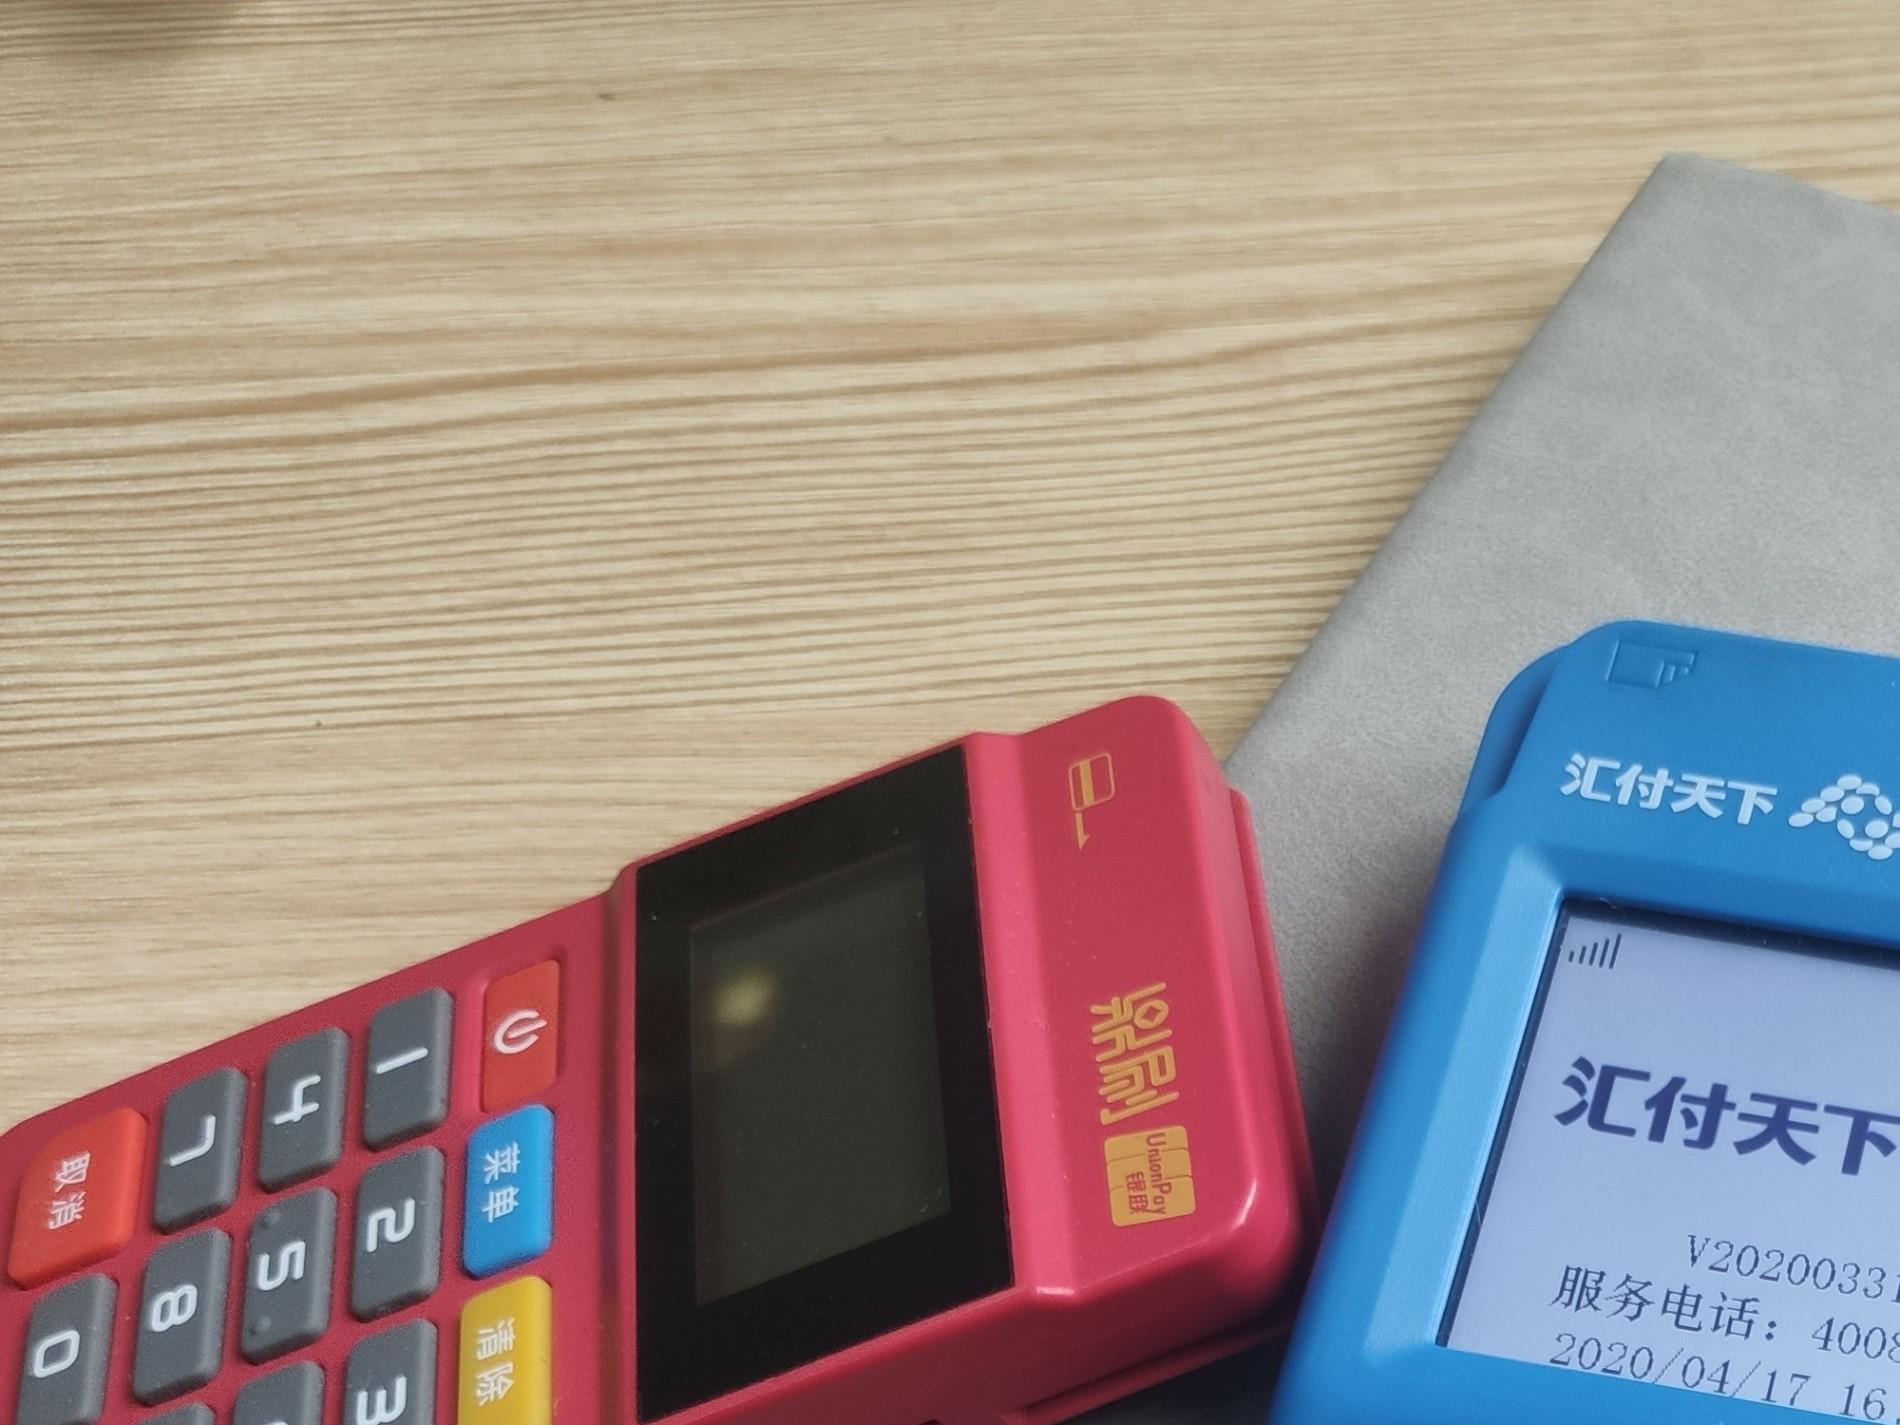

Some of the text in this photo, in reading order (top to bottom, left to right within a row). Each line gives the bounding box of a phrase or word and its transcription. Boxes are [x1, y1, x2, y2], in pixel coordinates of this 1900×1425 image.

[1559, 751, 1779, 829] 汇付天下
[273, 1075, 321, 1124] 4
[168, 1115, 216, 1167] 7
[49, 1150, 92, 1230] 取消
[481, 1140, 520, 1224] 菜单
[1125, 1171, 1149, 1214] 银联
[1146, 1132, 1173, 1215] UnionPay
[366, 1199, 415, 1253] 2
[257, 1240, 306, 1291] 5
[150, 1284, 198, 1333] 8
[33, 1329, 79, 1378] 0
[476, 1315, 515, 1406] 清除
[1548, 1332, 1812, 1407] 2020/04/17
